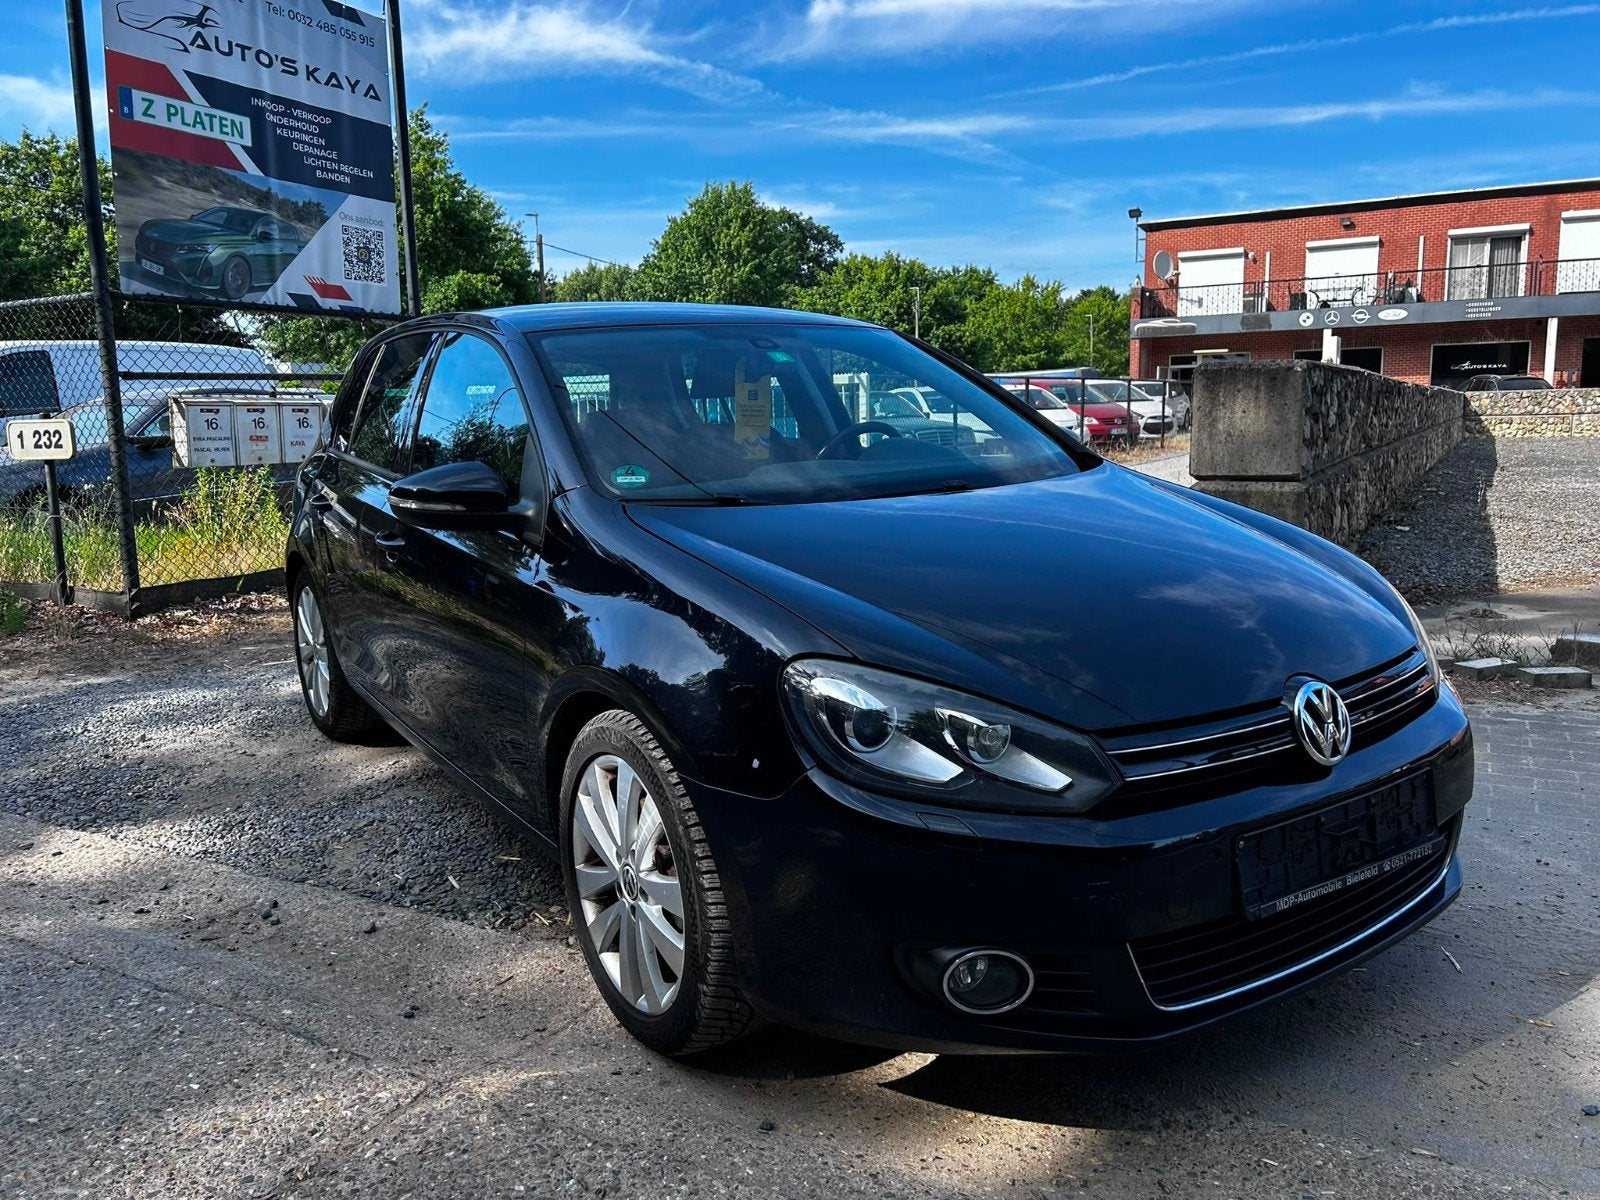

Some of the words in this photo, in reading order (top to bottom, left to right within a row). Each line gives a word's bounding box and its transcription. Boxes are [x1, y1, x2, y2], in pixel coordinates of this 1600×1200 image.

[265, 1, 285, 17] Tel:
[288, 9, 313, 28] 0032
[315, 19, 337, 35] 485
[340, 26, 357, 42] 055
[358, 31, 375, 48] 915
[189, 30, 298, 77] AUTO'S
[305, 64, 382, 102] KAYA
[140, 97, 156, 119] Z
[166, 102, 244, 140] PLATEN
[251, 97, 285, 113] INKOOP
[291, 108, 332, 125] VERKOOP
[265, 112, 319, 134] ONDERHOUD
[276, 127, 326, 146] KEURINGEN
[292, 142, 338, 160] DEPANAGE
[303, 156, 339, 171] LICHTEN
[340, 163, 374, 179] REGELEN
[316, 170, 351, 184] BANDEN
[339, 211, 353, 223] Ons
[353, 214, 385, 227] aanbod:
[204, 417, 219, 431] 16
[252, 417, 265, 430] 16
[296, 416, 309, 429] 16
[16, 431, 25, 449] 1
[32, 430, 64, 449] 232
[625, 465, 635, 476] 4
[1276, 879, 1342, 912] MDP-Automobile
[1346, 866, 1378, 886] Bielefeld
